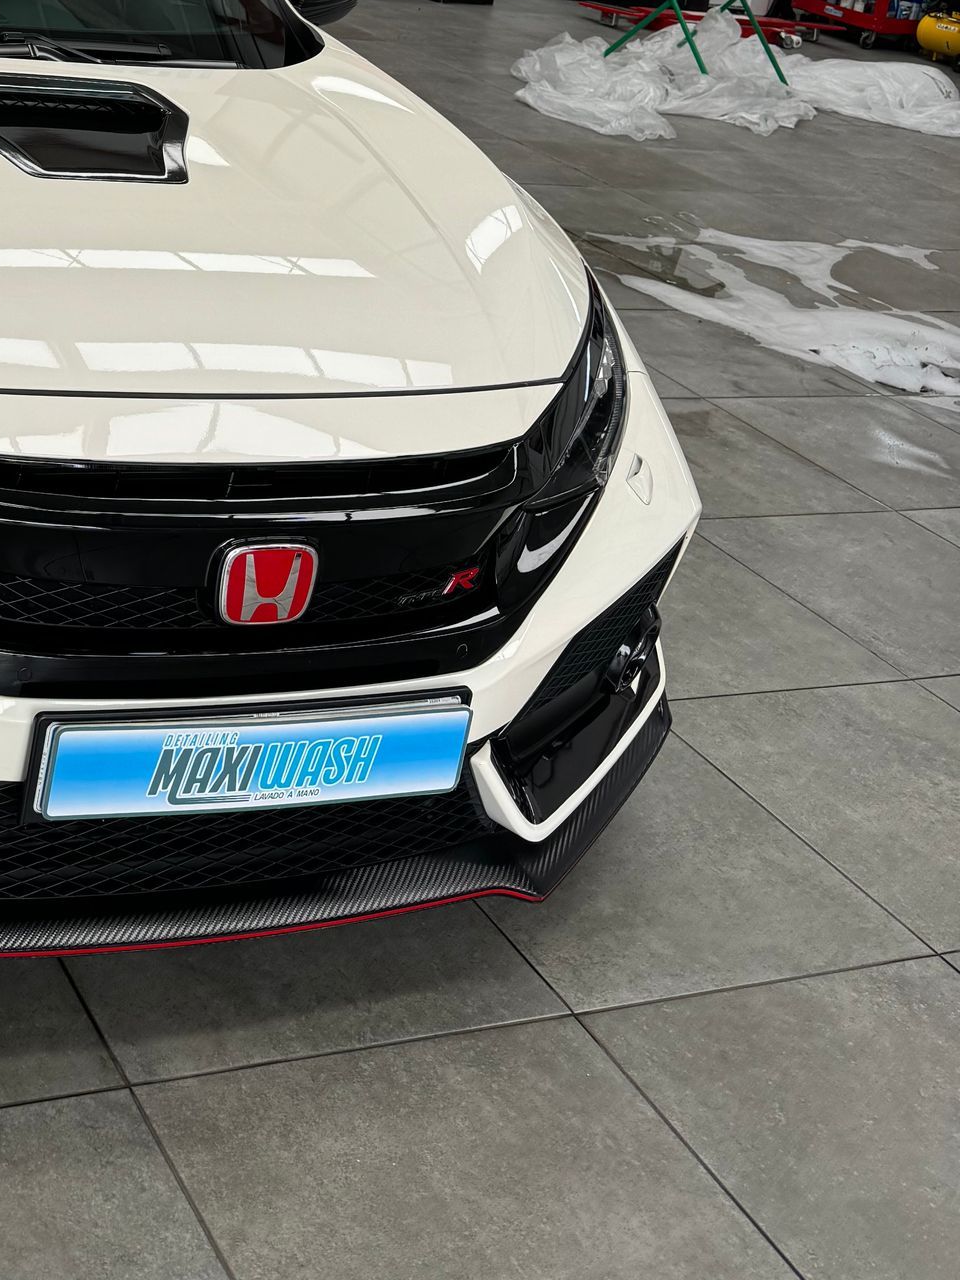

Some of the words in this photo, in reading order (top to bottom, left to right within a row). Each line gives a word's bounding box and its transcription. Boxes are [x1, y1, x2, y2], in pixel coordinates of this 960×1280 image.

[442, 567, 480, 596] R
[164, 732, 239, 747] DETAILING
[253, 791, 285, 801] LAVADO
[286, 791, 293, 799] A
[296, 787, 320, 797] MANO
